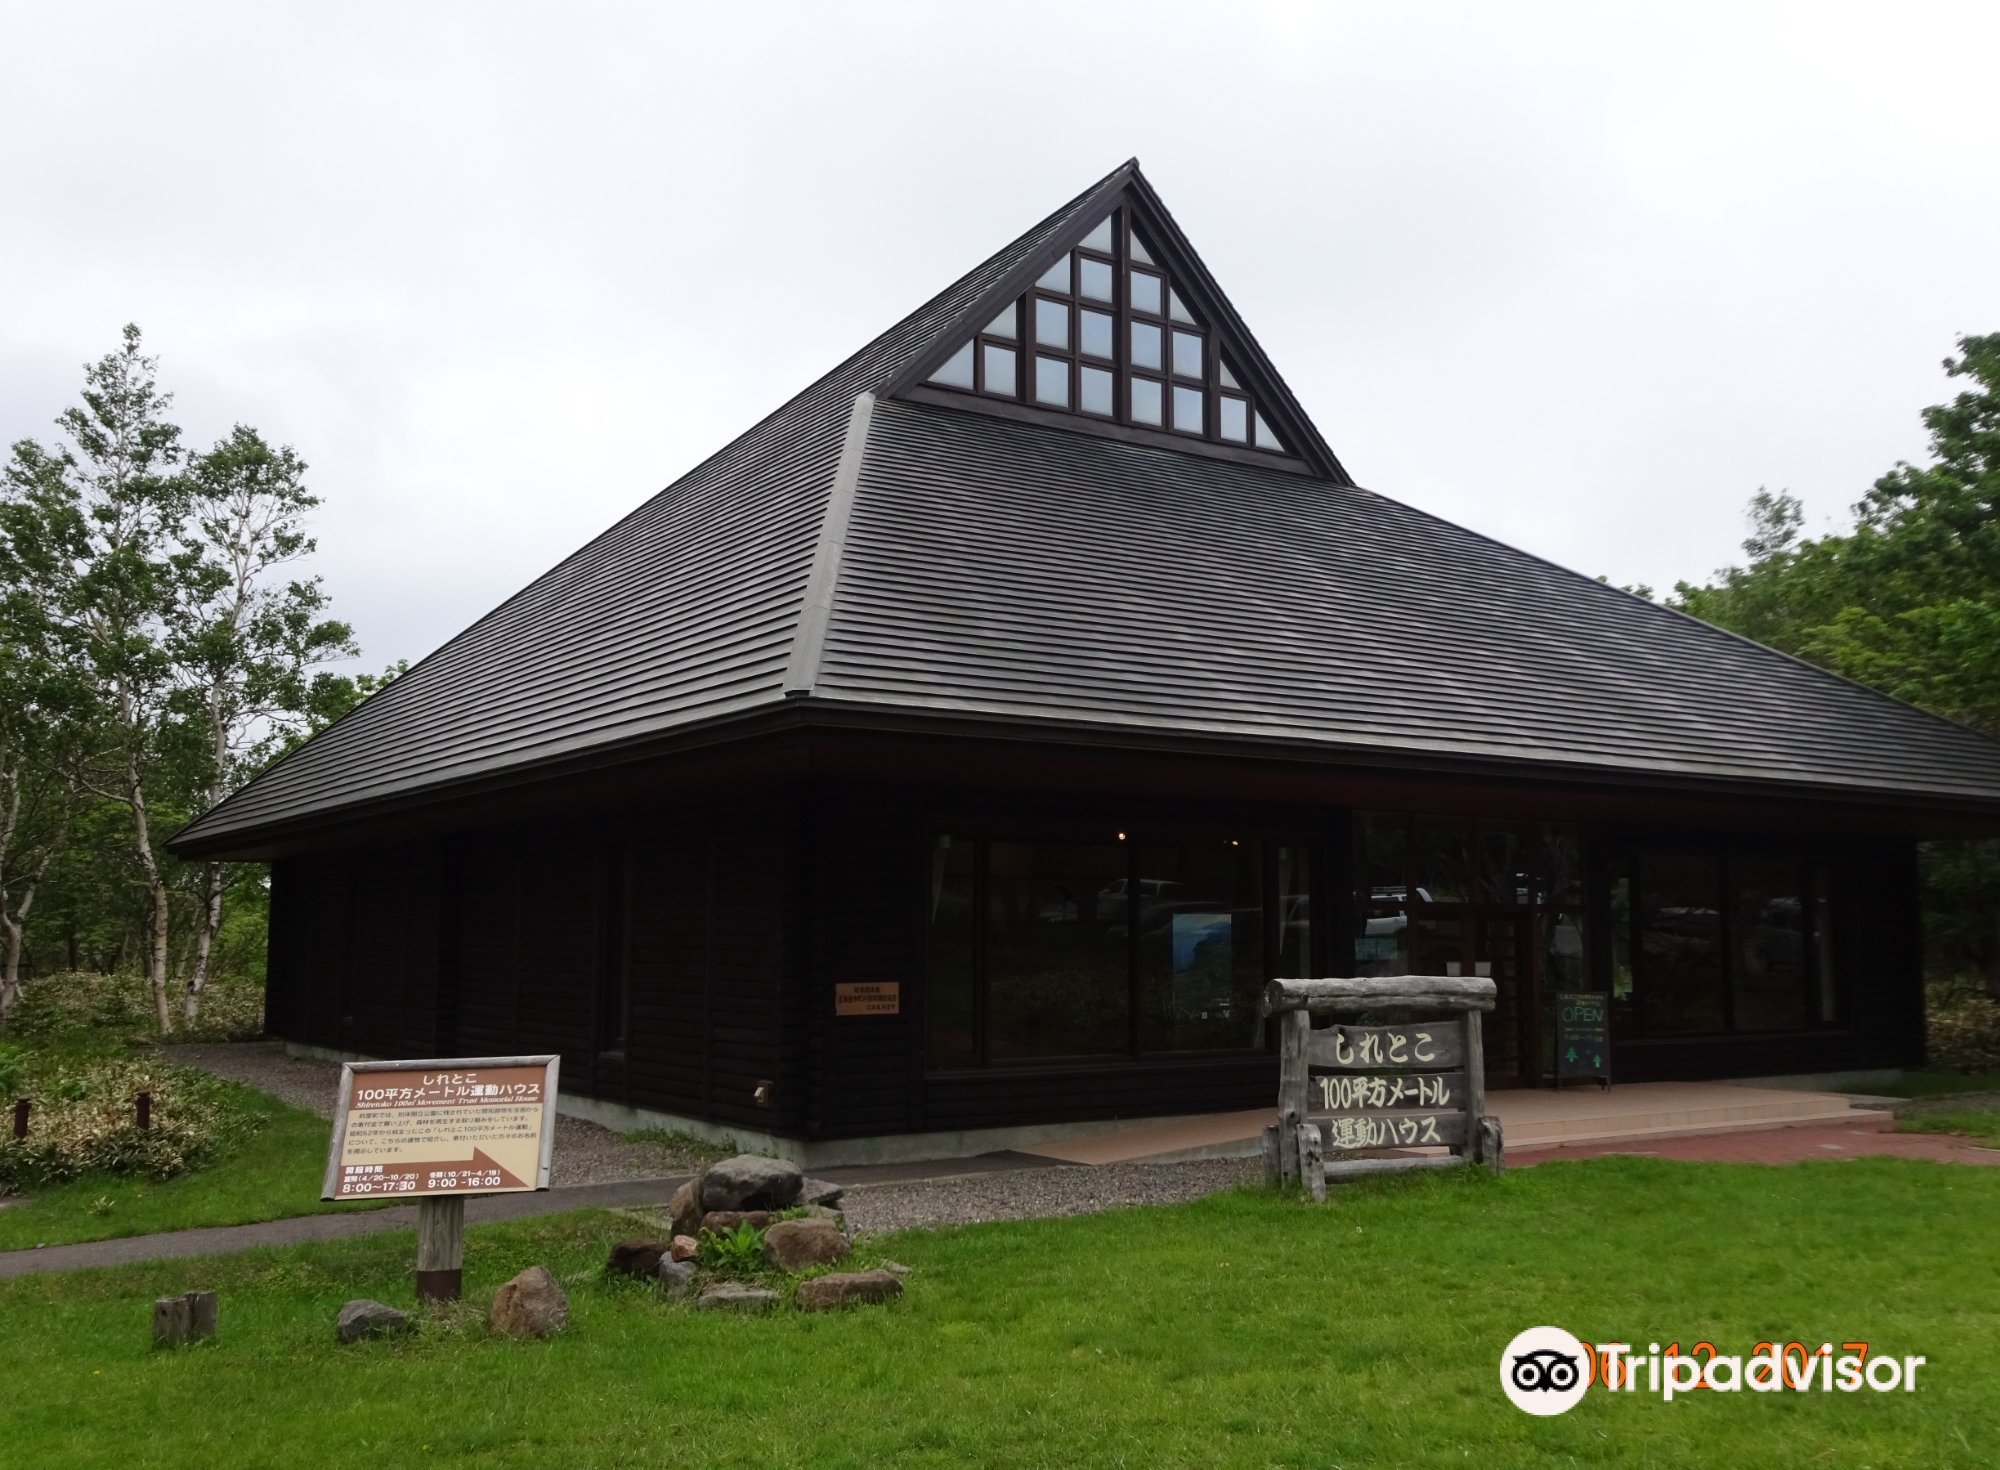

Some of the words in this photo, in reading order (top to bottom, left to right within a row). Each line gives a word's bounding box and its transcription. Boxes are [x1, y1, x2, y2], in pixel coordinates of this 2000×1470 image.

[1562, 1006, 1604, 1022] OPEN
[1335, 1032, 1436, 1065] しれとこ
[423, 1073, 478, 1086] しれとこ
[357, 1083, 540, 1100] 100平方メートル運動ハウス
[1320, 1076, 1450, 1110] 100平方メートル
[355, 1101, 392, 1109] Shiretoko
[416, 1098, 455, 1106] Movement
[458, 1097, 479, 1105] Trust
[480, 1096, 514, 1104] Memorial
[1332, 1116, 1441, 1149] 運動ハウス
